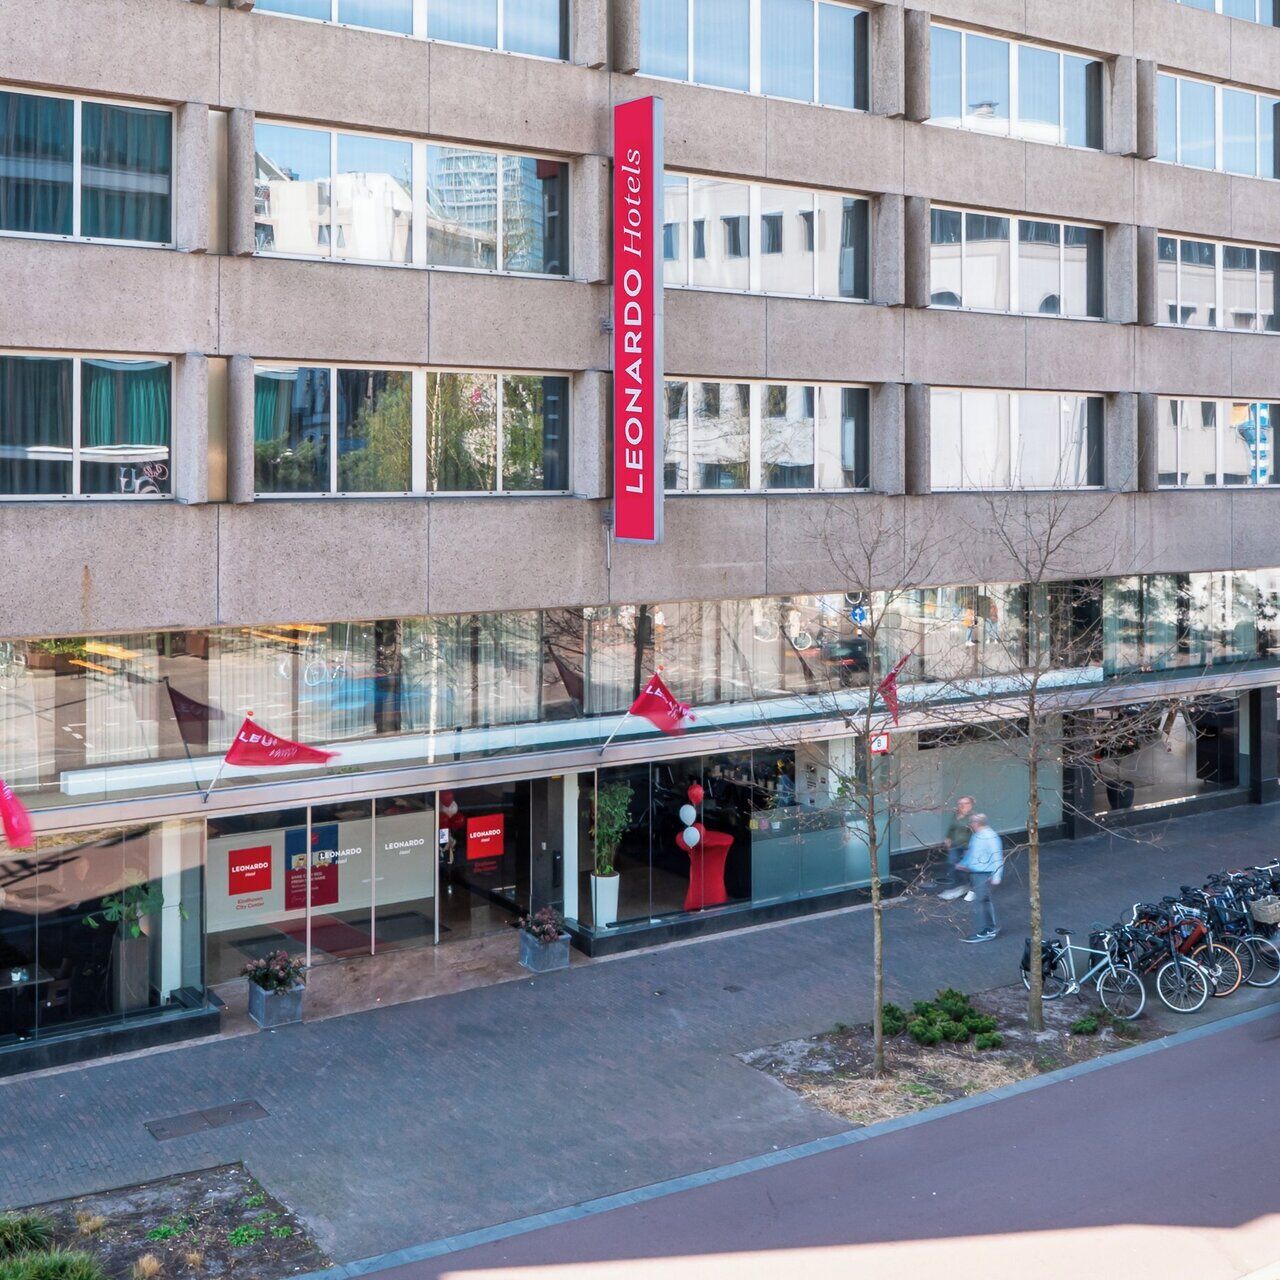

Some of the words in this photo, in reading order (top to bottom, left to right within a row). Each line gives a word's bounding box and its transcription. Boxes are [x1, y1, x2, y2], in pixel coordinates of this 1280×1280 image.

[621, 148, 642, 259] Hotels
[623, 268, 644, 495] LEONARDO
[469, 829, 501, 839] LEONARDO
[385, 839, 424, 850] LEONARDO
[320, 848, 362, 860] LEONARDO
[231, 862, 269, 873] LEONARDO
[236, 903, 247, 911] City
